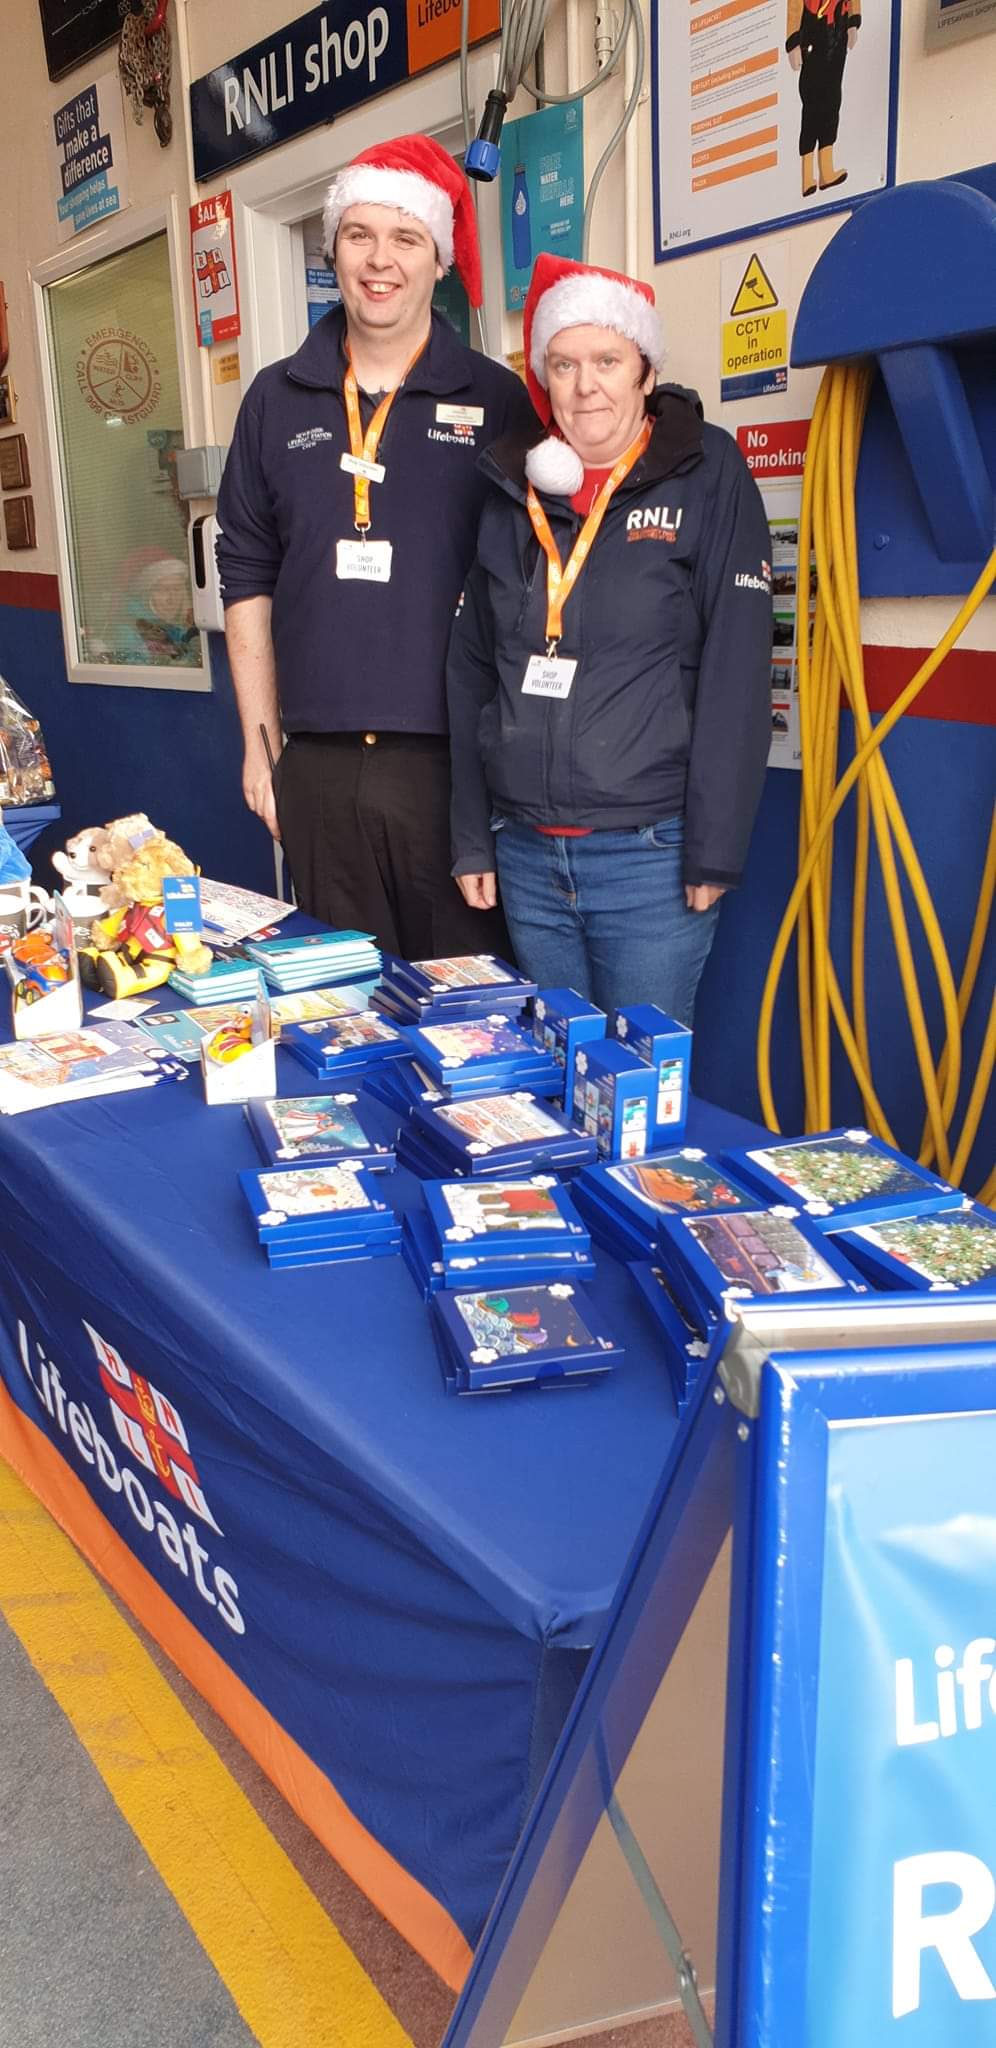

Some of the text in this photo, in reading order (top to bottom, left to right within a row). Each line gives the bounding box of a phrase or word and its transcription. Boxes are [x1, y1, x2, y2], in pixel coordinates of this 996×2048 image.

[223, 6, 389, 137] RNLI shop
[56, 94, 96, 139] Gifts that
[65, 124, 98, 161] make a
[64, 146, 109, 188] difference
[106, 193, 118, 209] sea
[736, 317, 770, 337] CCTV
[748, 336, 758, 350] in
[727, 347, 783, 370] operation
[76, 361, 88, 394] CALL
[762, 383, 787, 393] Lifeboats
[427, 428, 476, 446] Lifeboats
[747, 430, 769, 448] No
[626, 506, 683, 531] RNLI
[531, 679, 563, 690] VOLUNTEER
[542, 670, 558, 679] SHOP
[18, 1319, 246, 1636] Lifeboats
[895, 1637, 996, 1747] Lif
